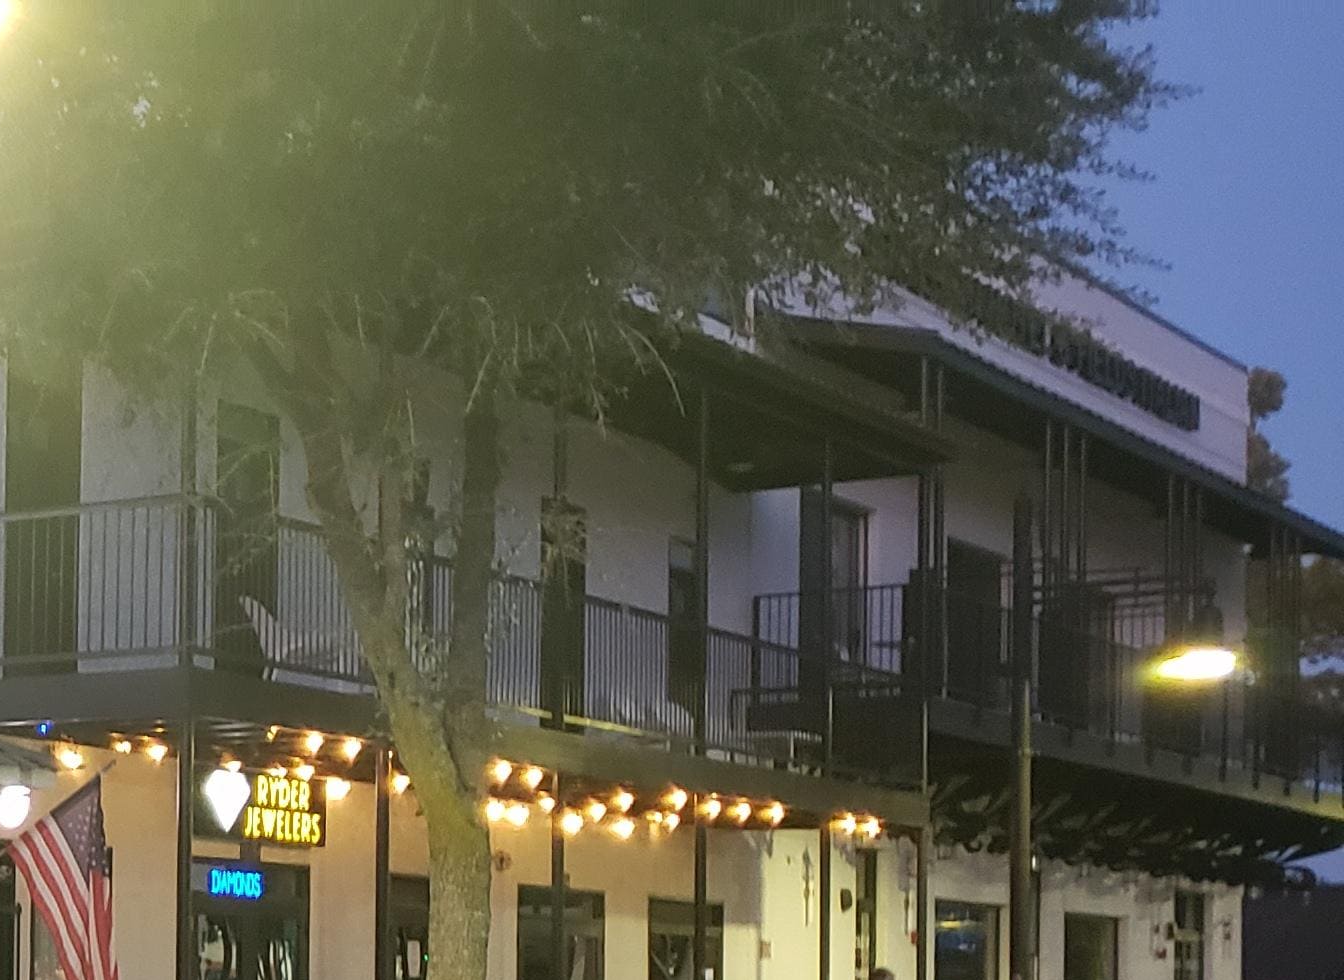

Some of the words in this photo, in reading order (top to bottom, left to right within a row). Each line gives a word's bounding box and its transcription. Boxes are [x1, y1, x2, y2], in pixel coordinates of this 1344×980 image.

[256, 774, 310, 811] RYDER
[244, 806, 321, 844] JEWELERS
[210, 868, 262, 899] DIAMONDS
